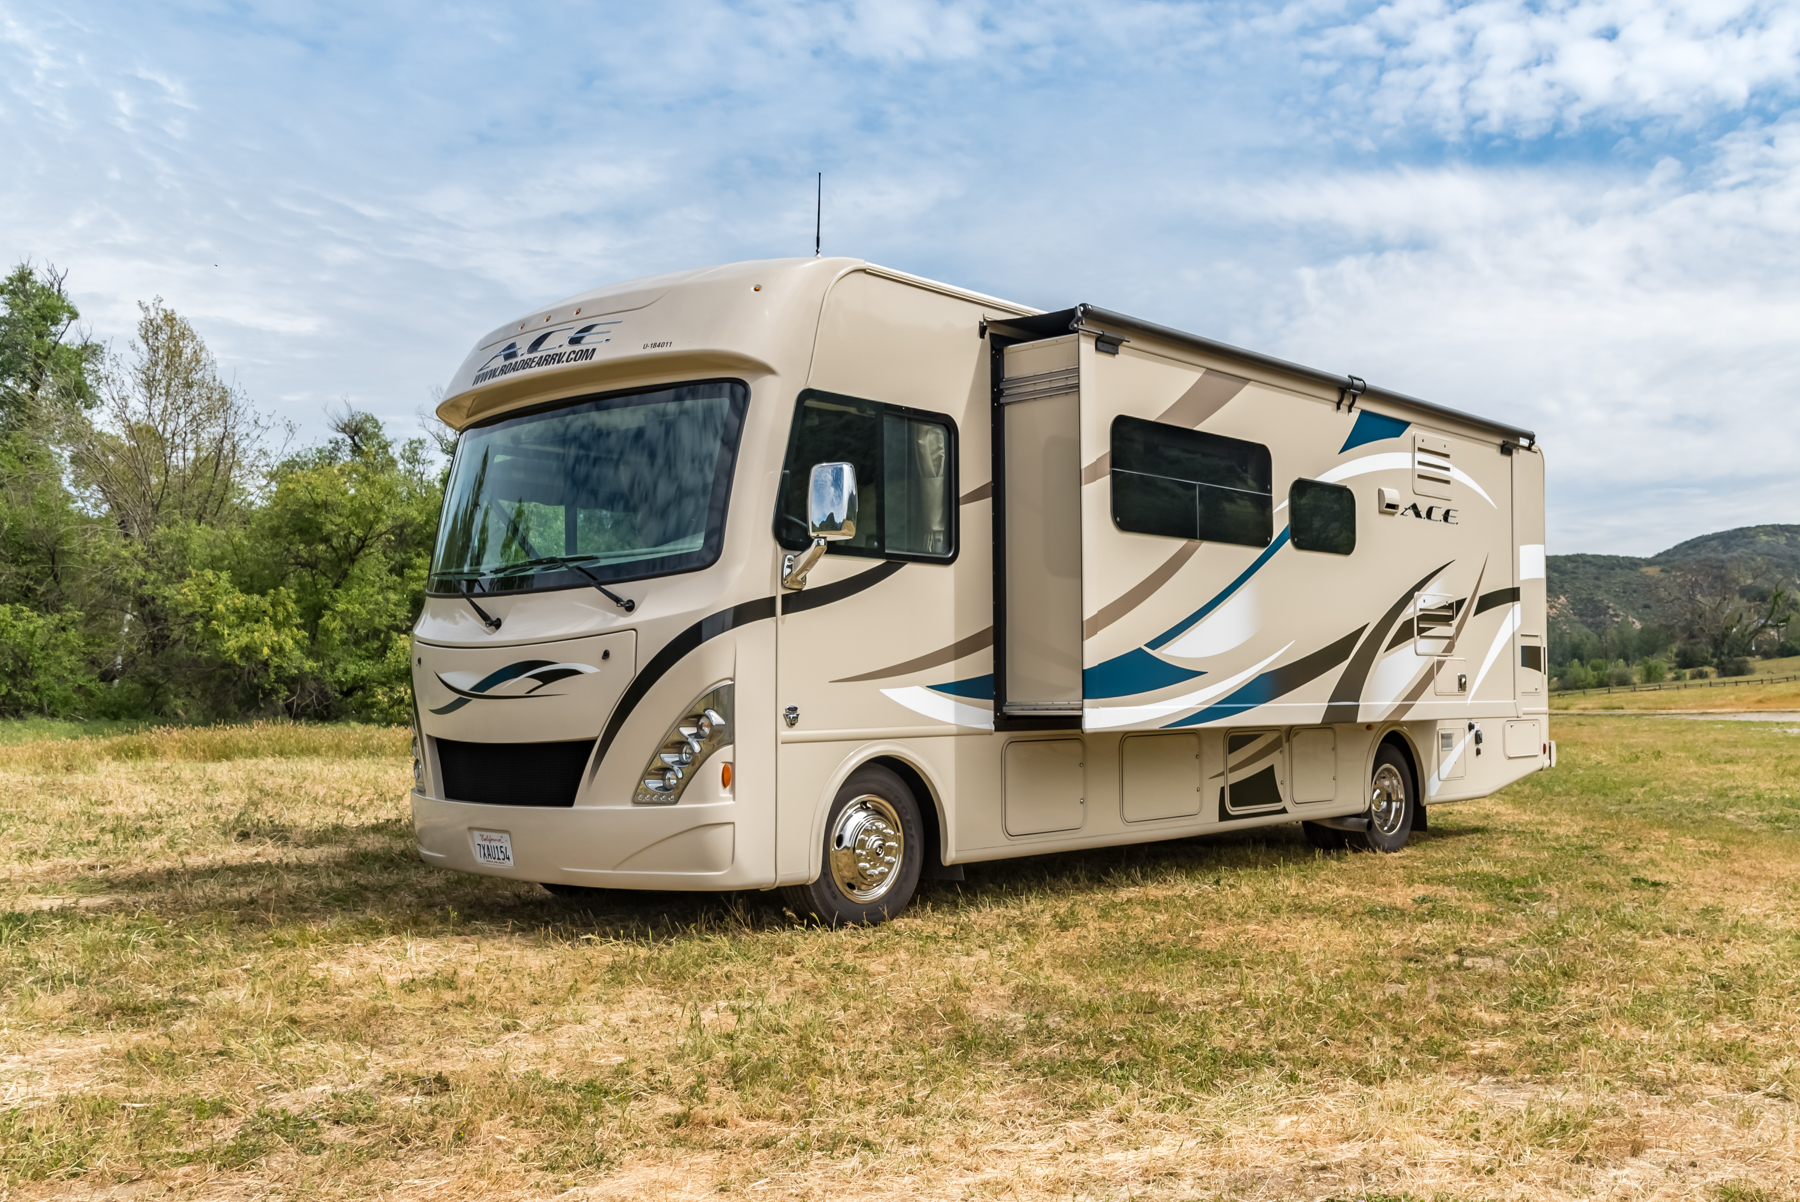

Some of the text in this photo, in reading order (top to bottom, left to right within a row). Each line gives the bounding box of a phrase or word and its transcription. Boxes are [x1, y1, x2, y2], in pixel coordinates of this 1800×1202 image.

[642, 341, 673, 350] U-184011
[472, 347, 597, 386] WWW.ROADBEARRV.COM
[1400, 502, 1459, 525] A.C.E.
[477, 843, 511, 862] 7XAU154
